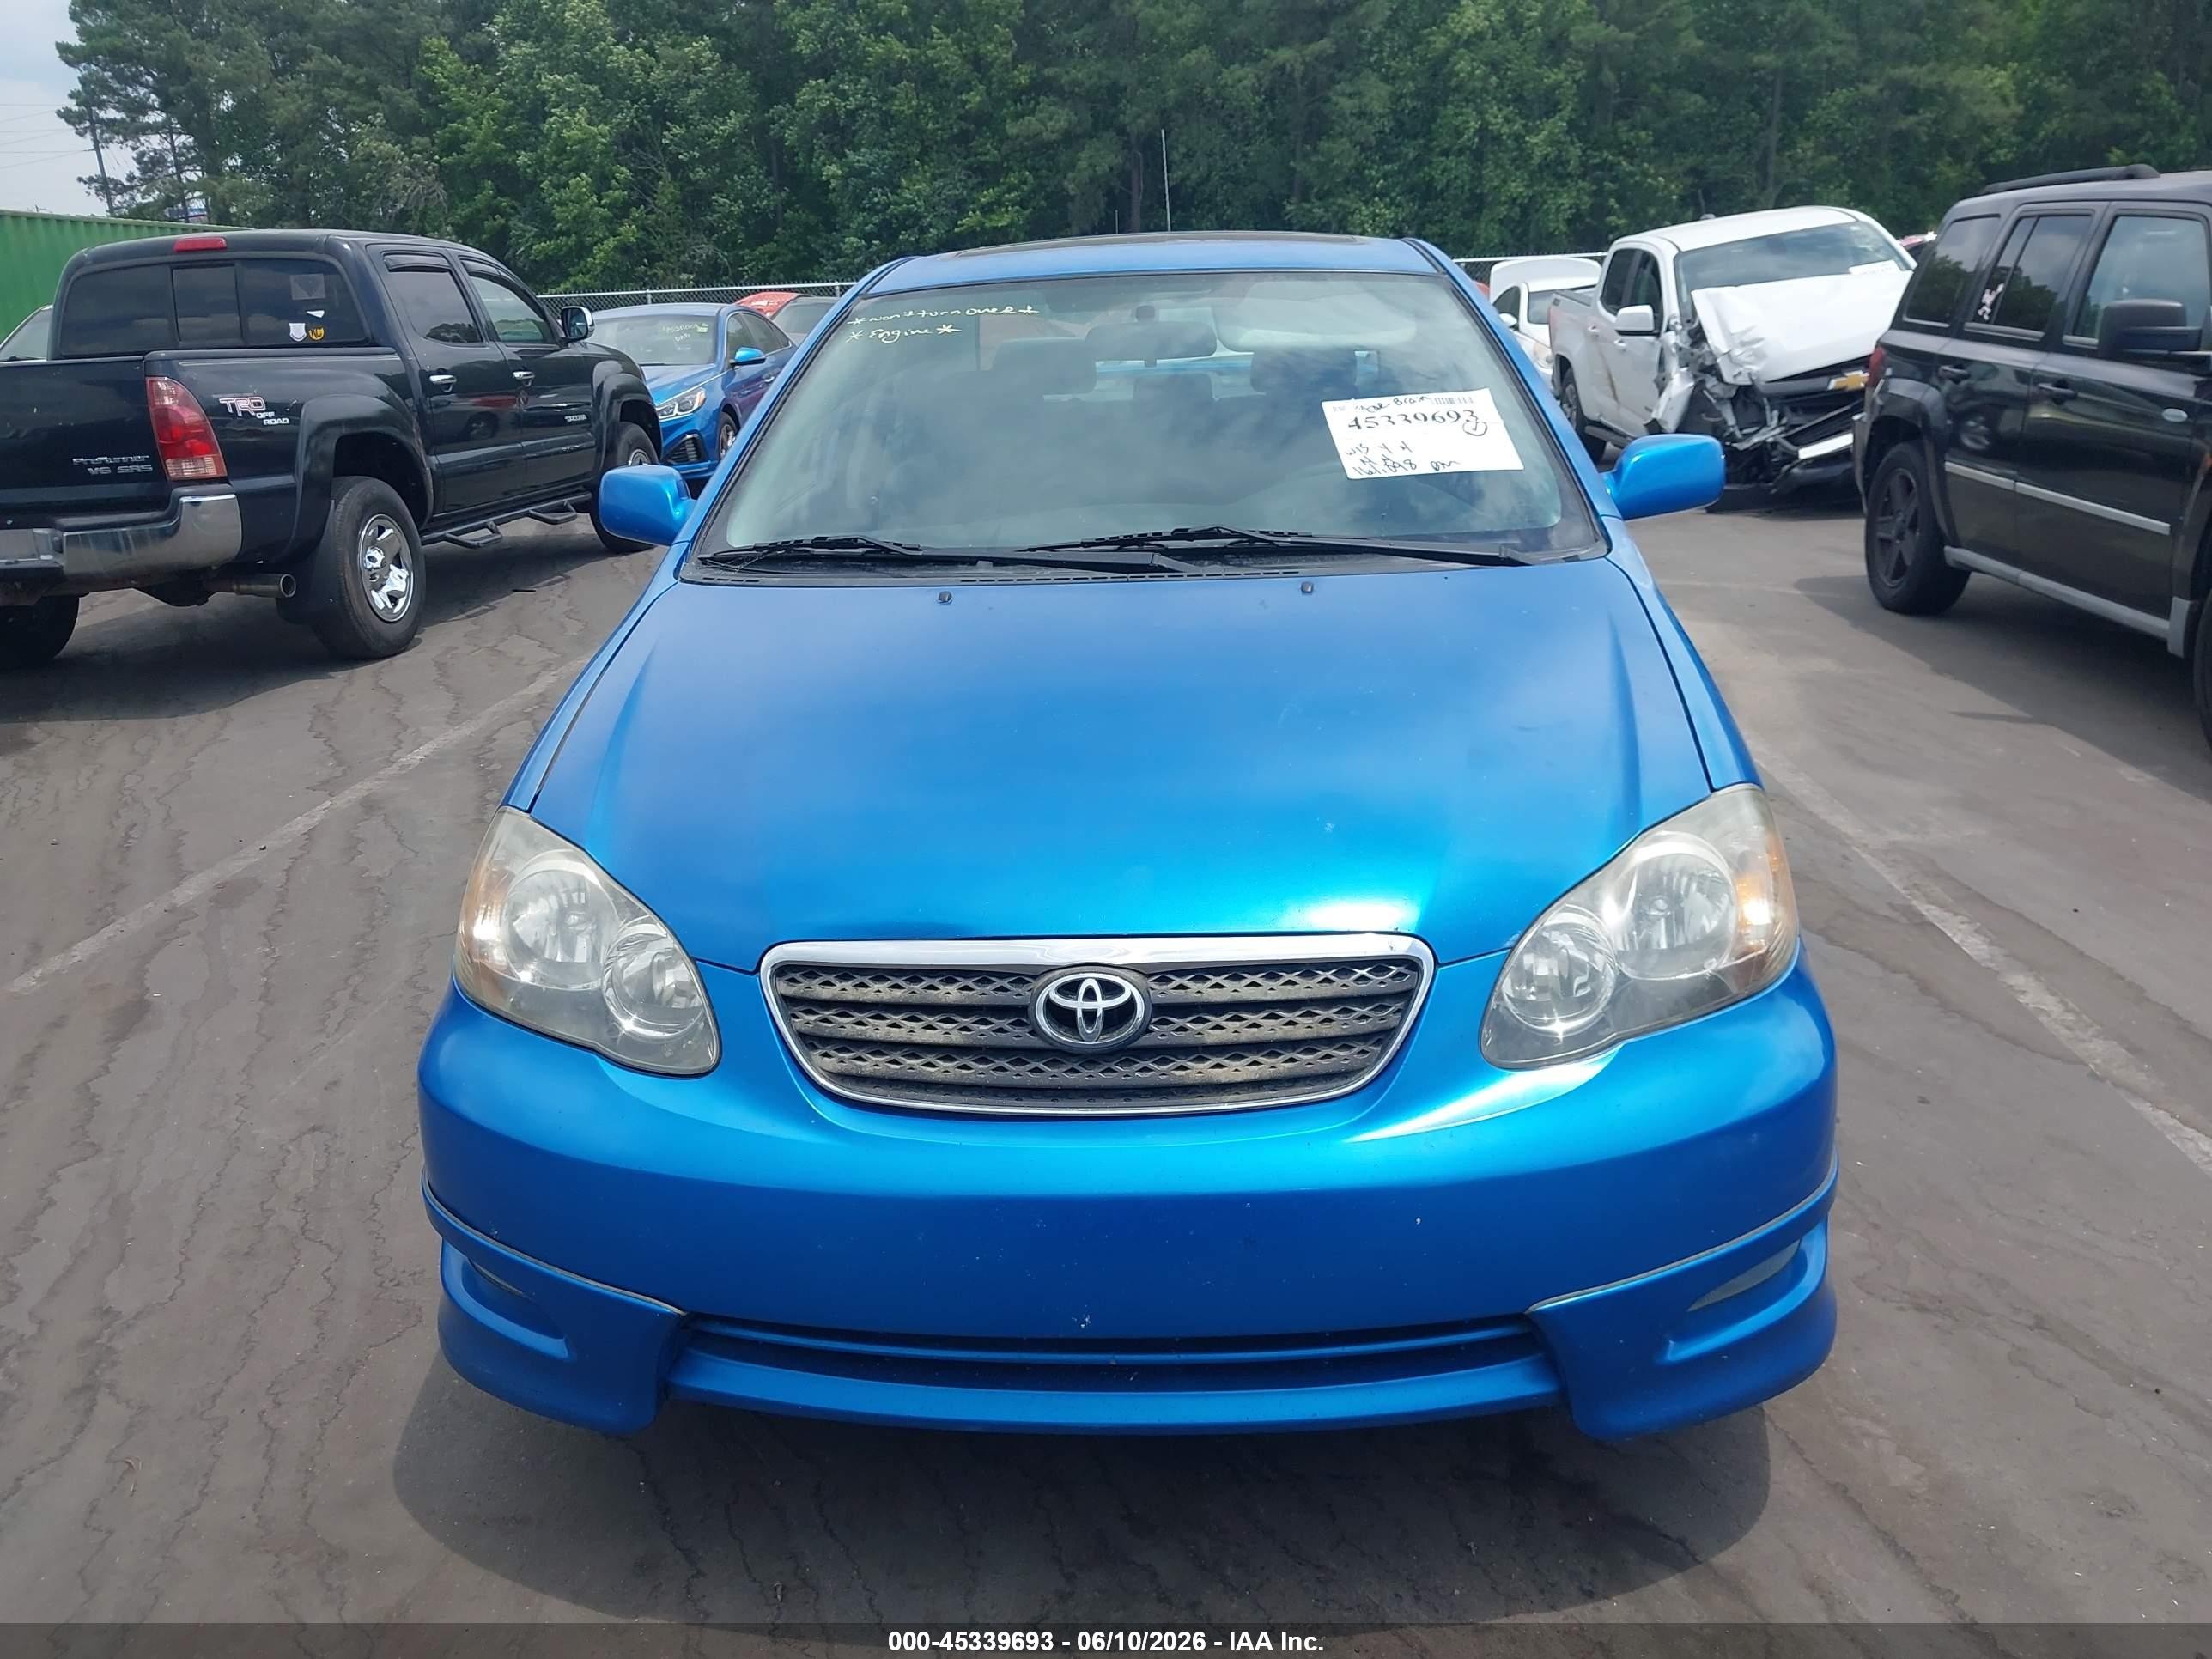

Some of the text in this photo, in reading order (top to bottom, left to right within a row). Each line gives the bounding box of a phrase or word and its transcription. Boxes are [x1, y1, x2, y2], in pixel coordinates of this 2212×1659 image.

[917, 309, 961, 318] turn
[868, 328, 933, 343] Engine
[219, 396, 266, 416] TRD
[263, 417, 289, 426] ROAD
[87, 464, 154, 475] V6 SR5
